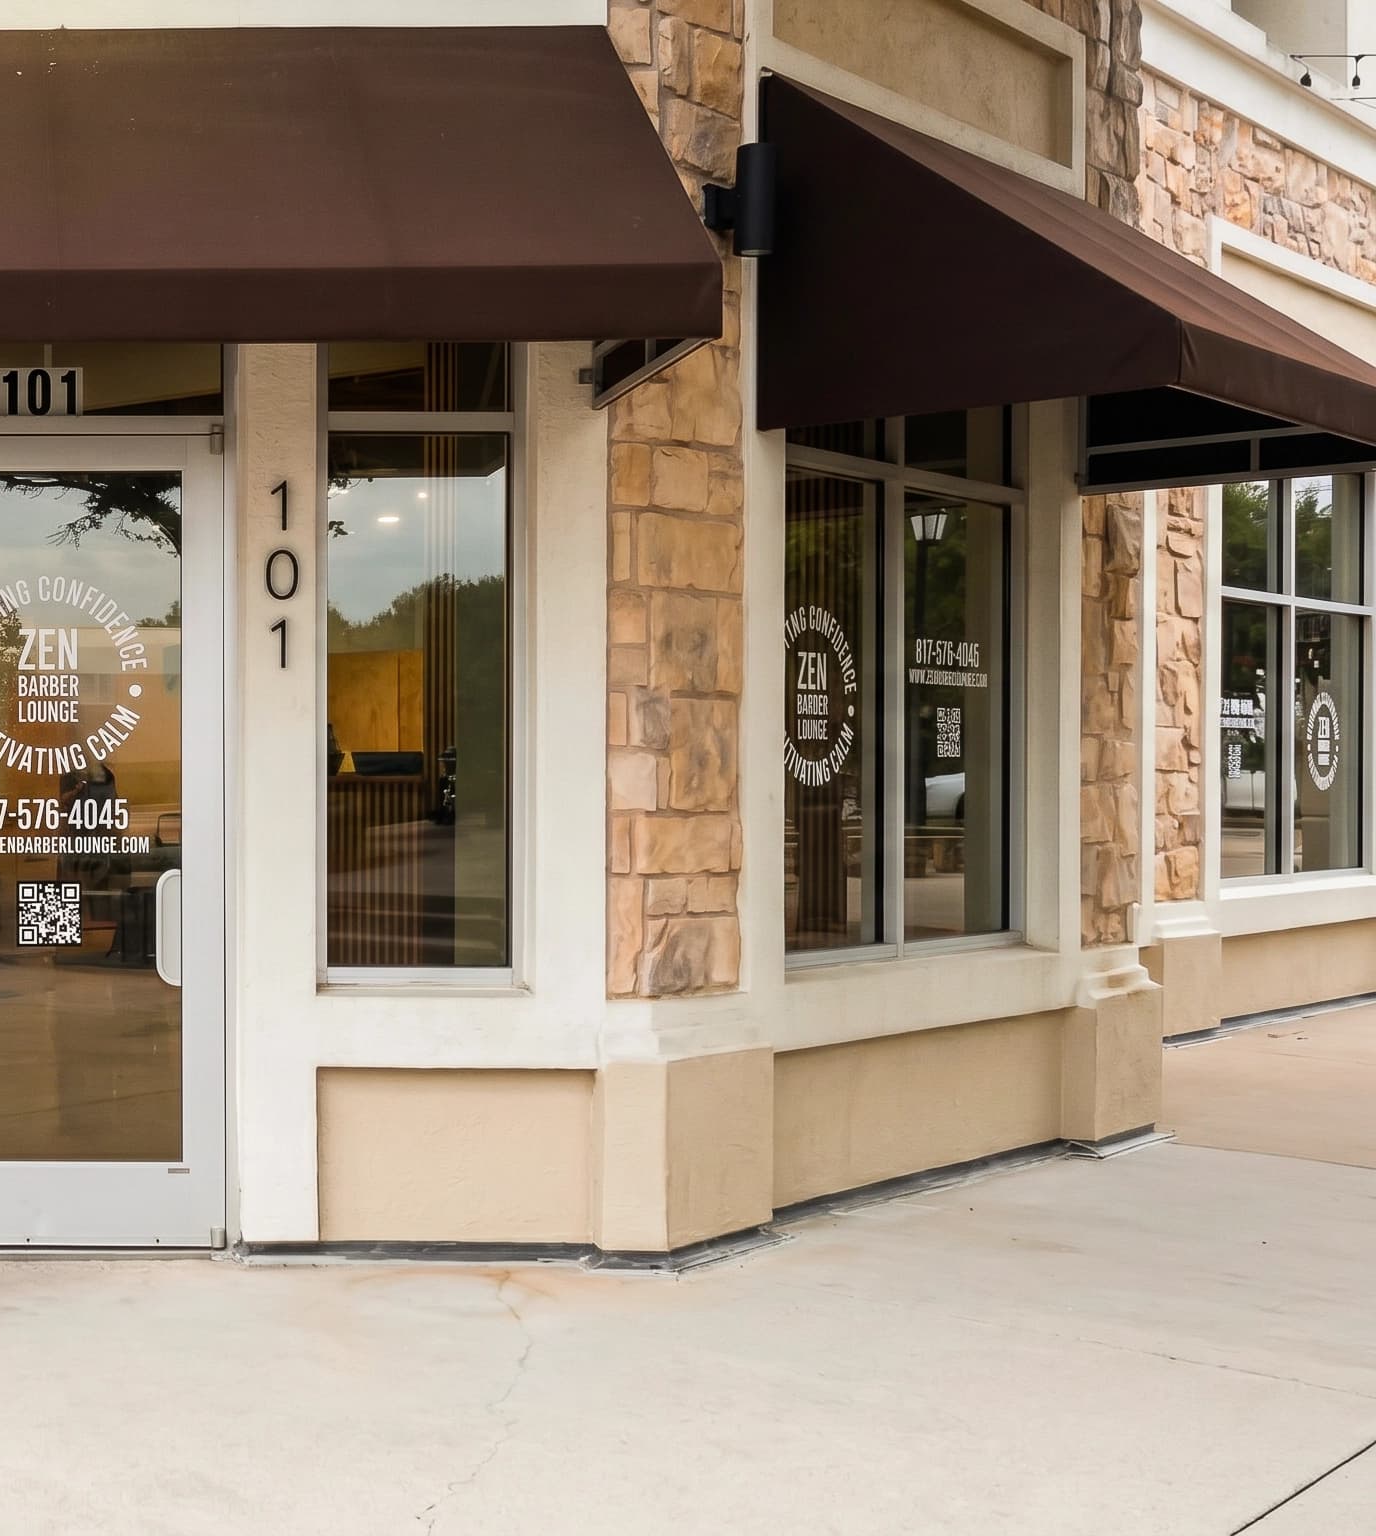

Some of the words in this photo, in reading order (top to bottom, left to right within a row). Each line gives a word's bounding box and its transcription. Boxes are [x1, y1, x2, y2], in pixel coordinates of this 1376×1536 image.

[2, 368, 77, 416] 101
[265, 480, 299, 669] 101
[38, 576, 147, 672] CONFIDENCE
[18, 628, 78, 671] ZEN
[797, 651, 827, 691] ZEN
[809, 605, 857, 695] CONFIDENCE
[18, 675, 79, 697] BARBER
[18, 701, 79, 723] LOUNGE
[86, 704, 141, 761] CALM
[797, 719, 829, 740] LOUNGE
[829, 722, 855, 774] CALM
